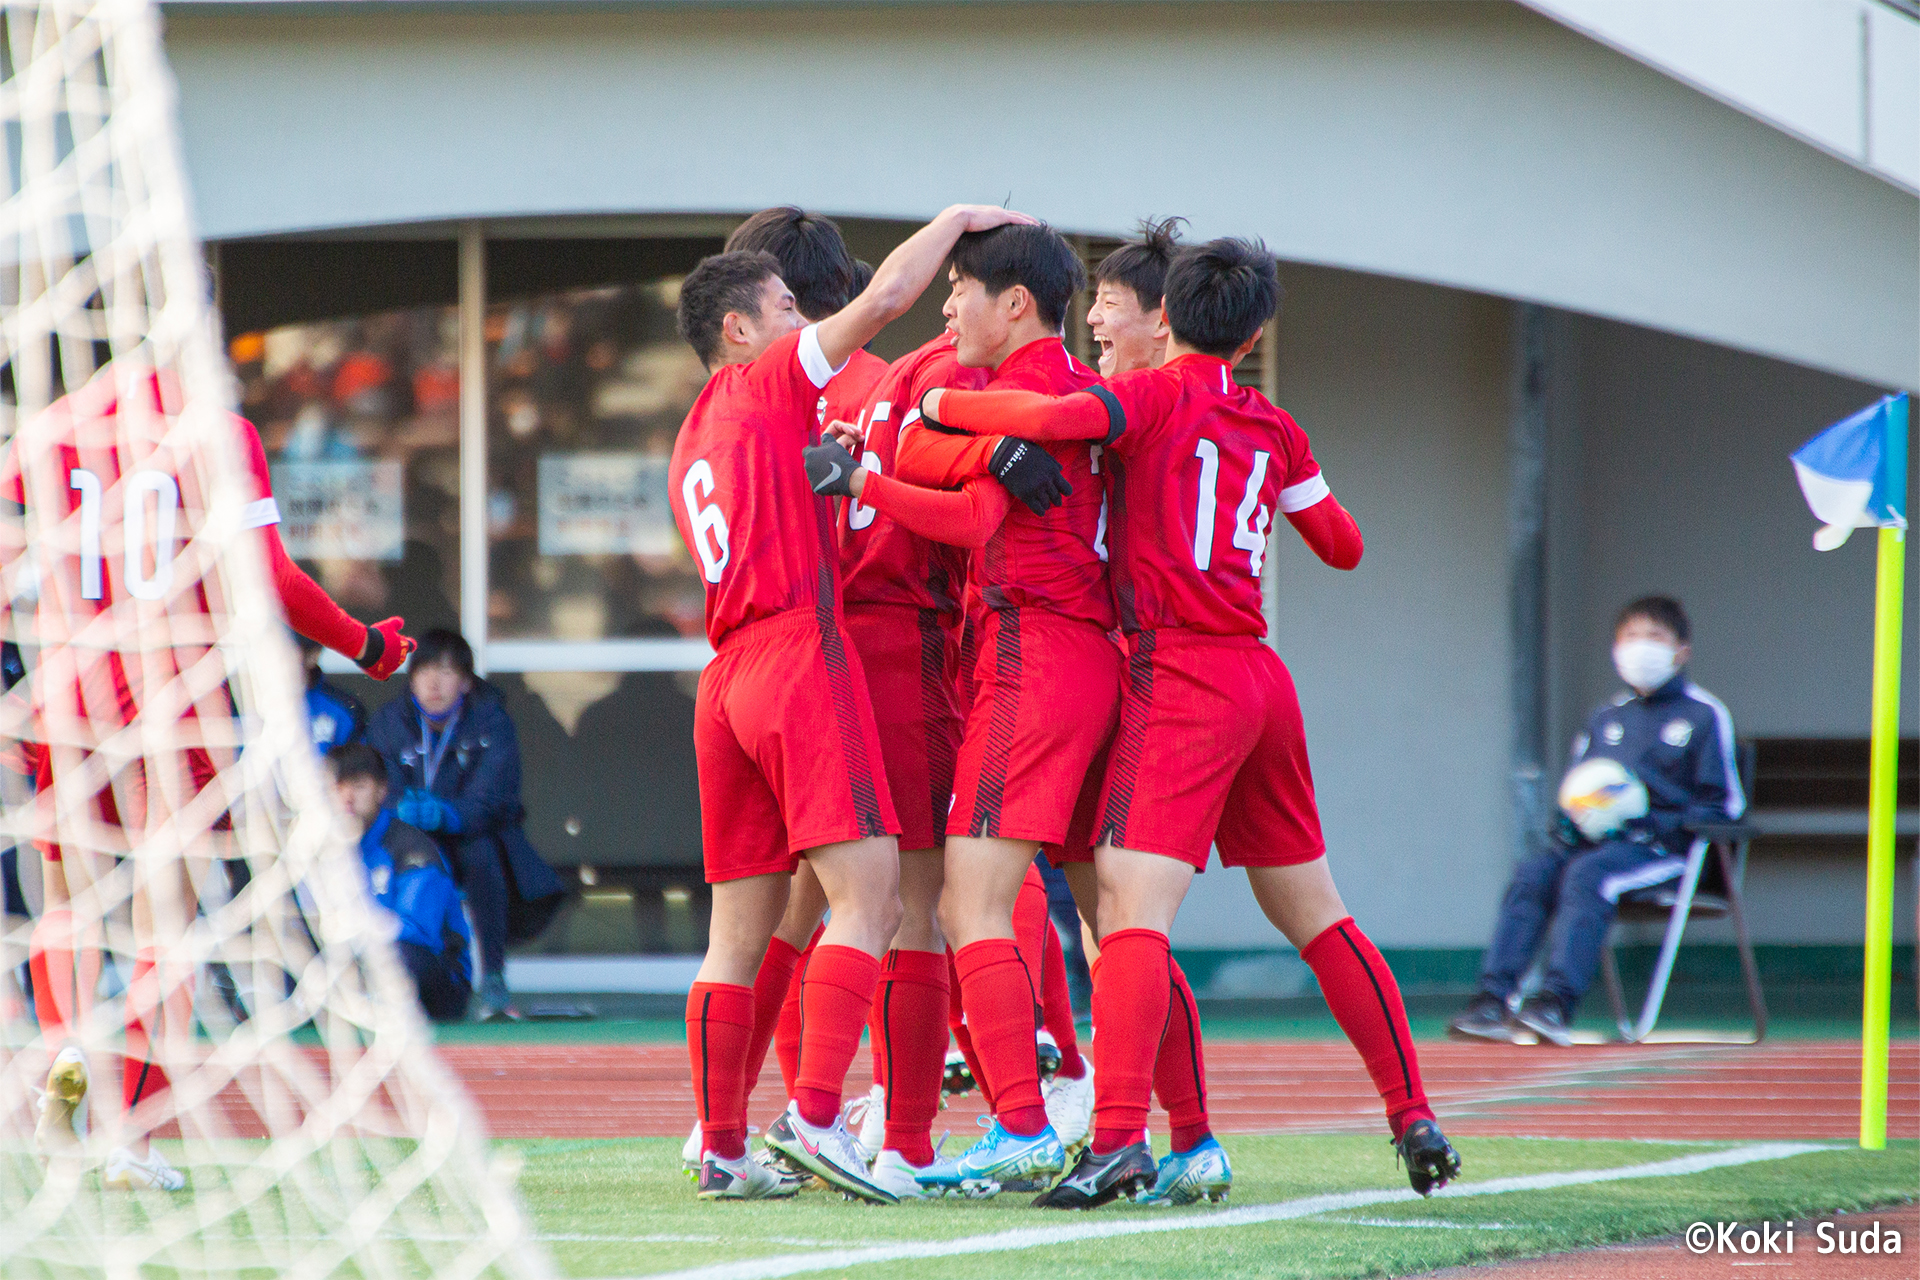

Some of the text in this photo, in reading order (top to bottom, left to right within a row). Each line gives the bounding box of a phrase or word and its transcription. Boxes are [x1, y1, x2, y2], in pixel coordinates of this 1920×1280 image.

[70, 468, 180, 601] 10
[682, 458, 731, 584] 6
[1194, 437, 1271, 577] 14
